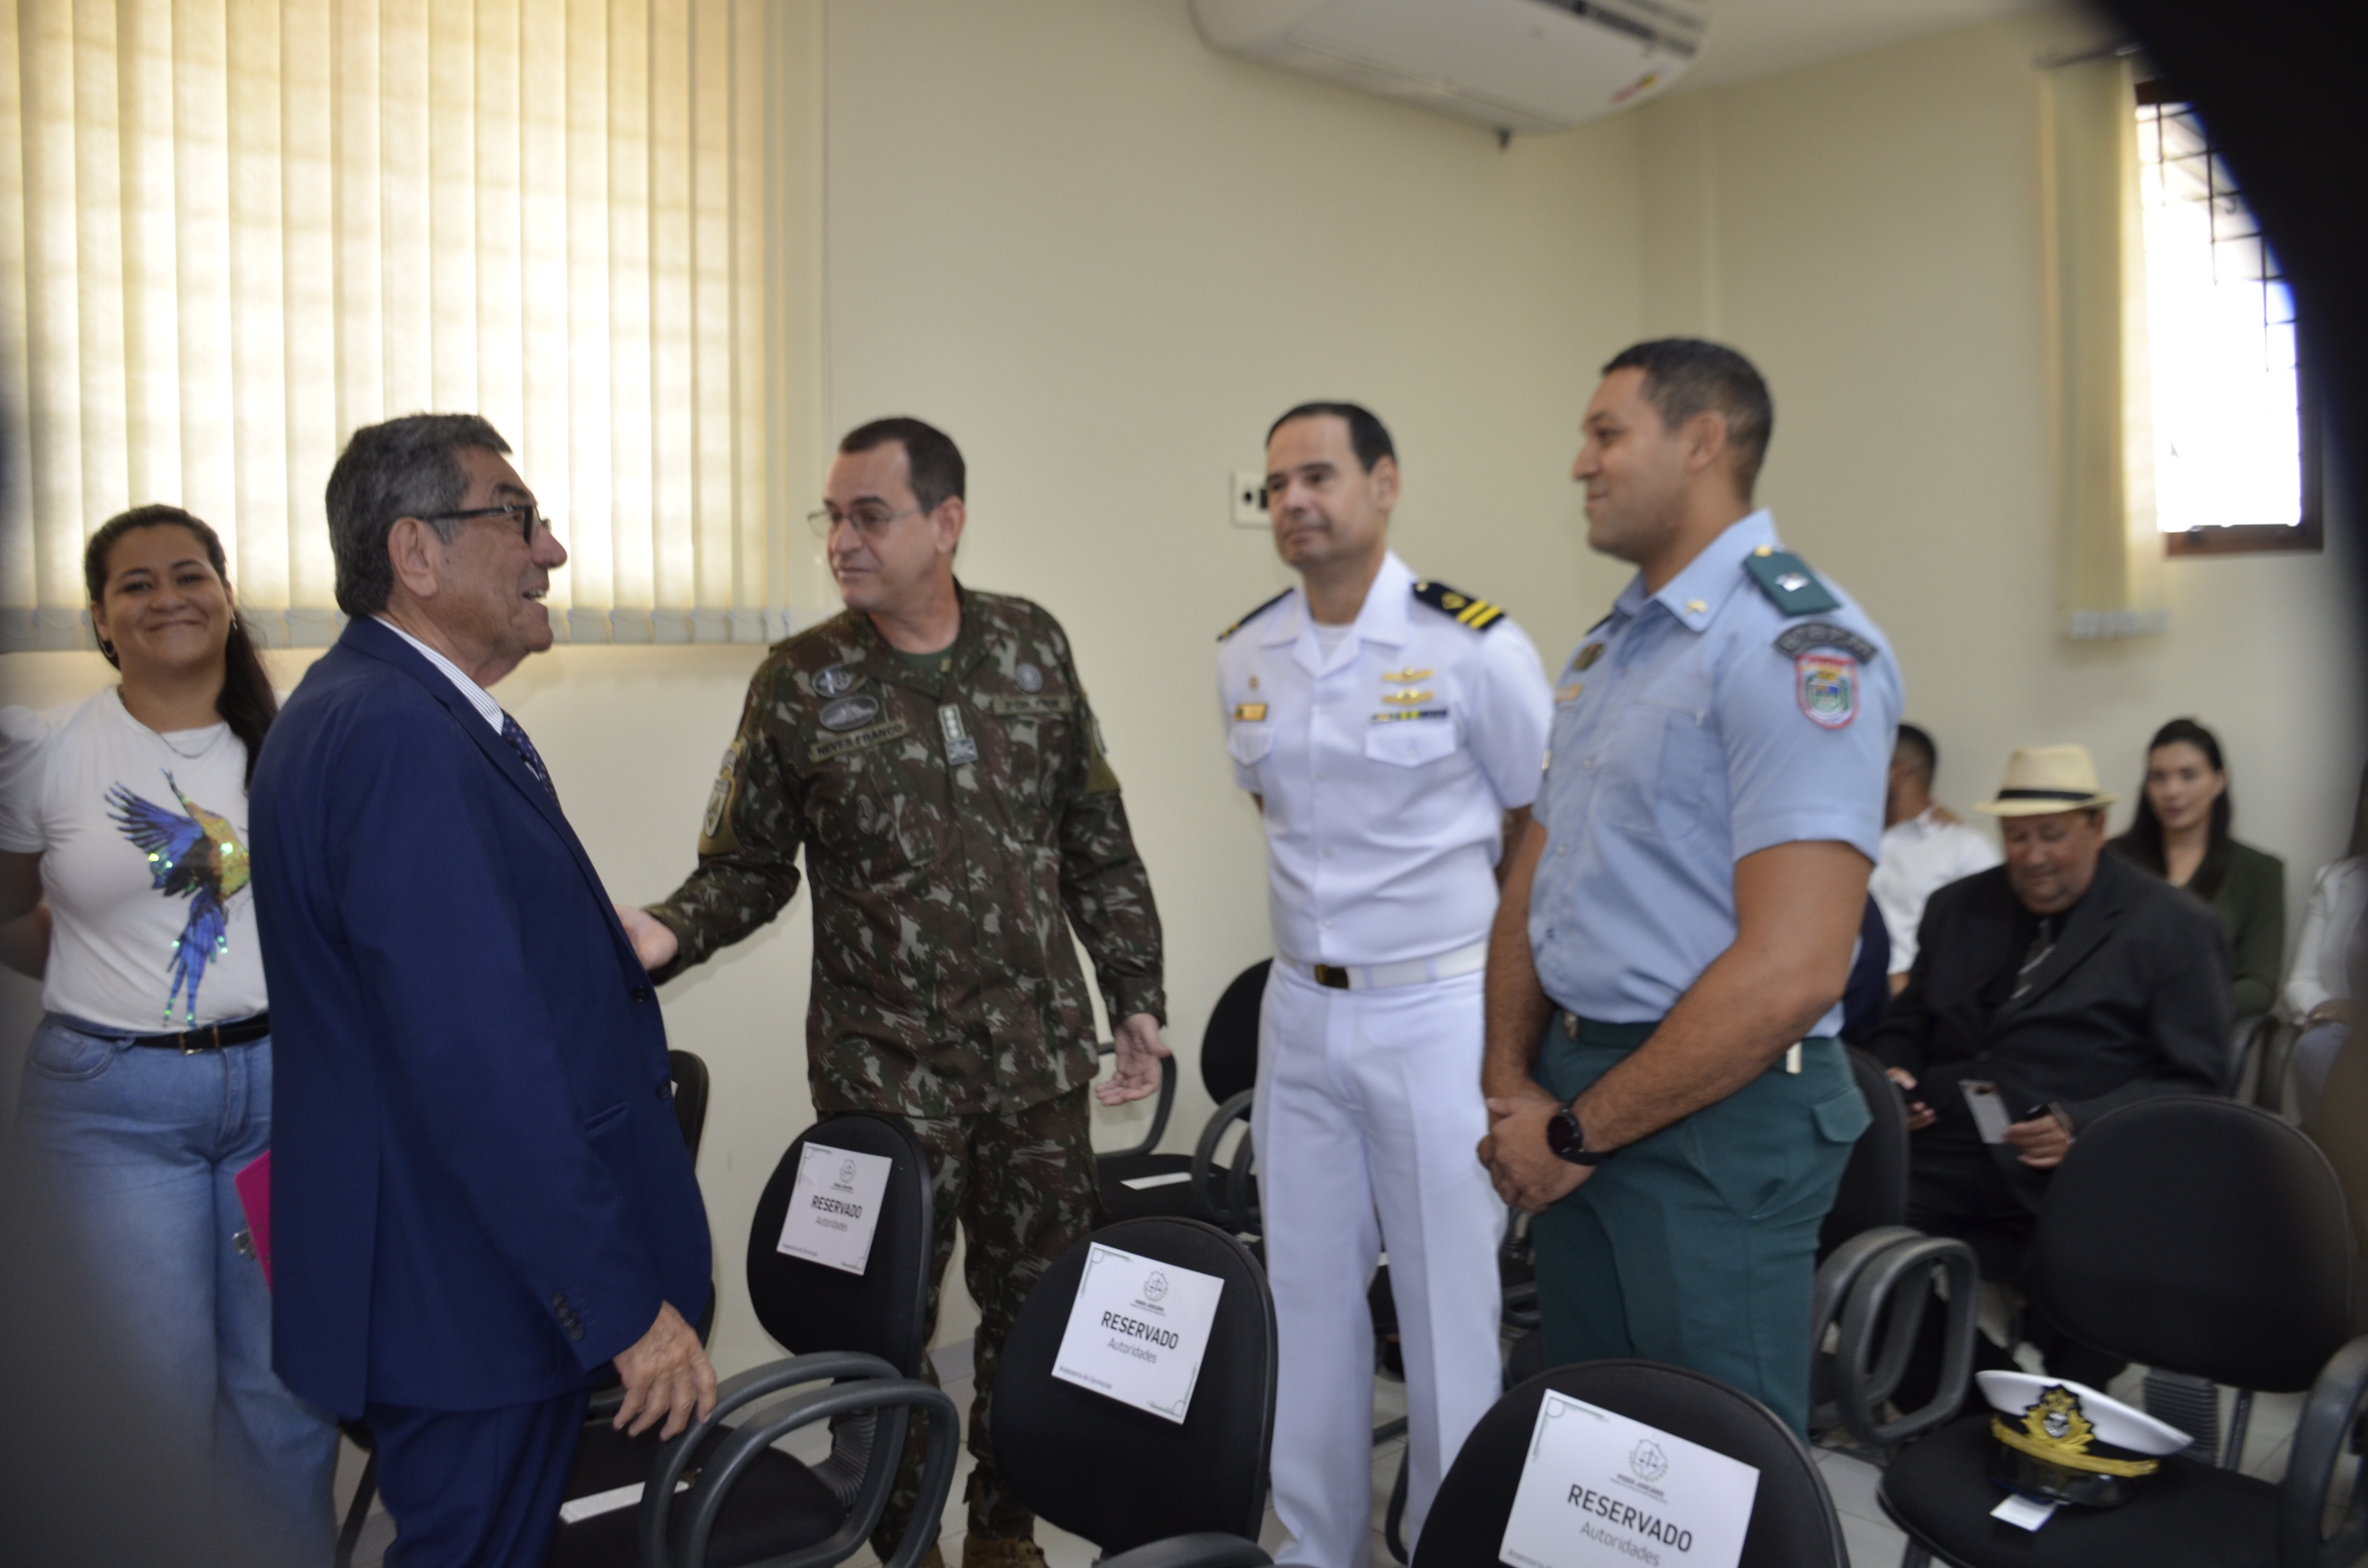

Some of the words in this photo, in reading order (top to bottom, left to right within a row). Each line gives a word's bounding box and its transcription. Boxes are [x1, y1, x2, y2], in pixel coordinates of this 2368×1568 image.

[810, 1195, 863, 1219] RESERVADO
[1100, 1311, 1179, 1350] RESERVADO
[1107, 1337, 1157, 1363] Autoridades
[1567, 1483, 1692, 1553] RESERVADO
[1579, 1521, 1661, 1568] Autoridades
